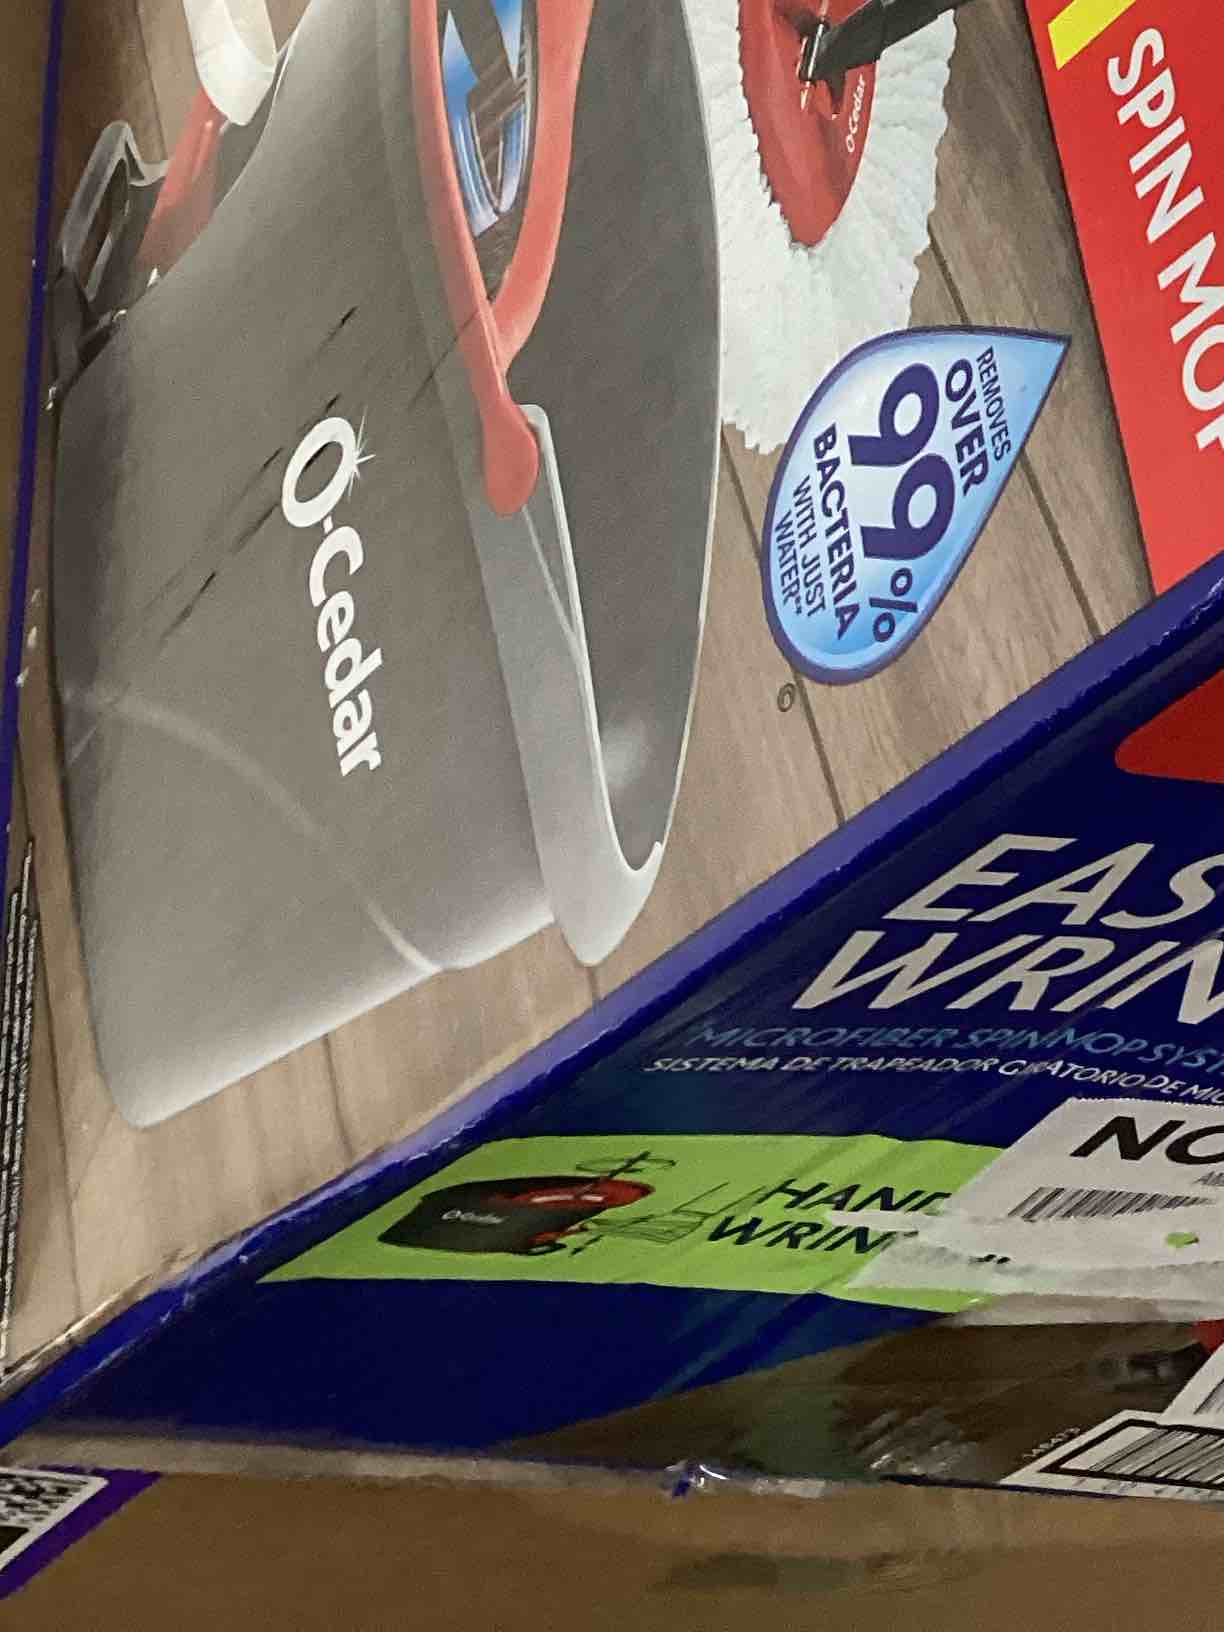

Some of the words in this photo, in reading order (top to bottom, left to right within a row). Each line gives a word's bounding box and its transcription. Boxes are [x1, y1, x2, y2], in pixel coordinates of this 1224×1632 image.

[1108, 27, 1205, 243] SPIN
[945, 359, 990, 496] OVER
[976, 345, 1012, 462] REMOVES
[792, 475, 815, 549] WITH
[813, 421, 861, 641] BACTERIA
[848, 362, 957, 643] 99%
[281, 416, 383, 777] O-Cedar
[800, 549, 827, 618] JUST
[644, 1055, 780, 1072] SISTEMA
[780, 1056, 830, 1072] DE
[828, 1055, 999, 1074] TRAPEADOR
[1143, 1075, 1186, 1095] DE
[685, 1023, 958, 1049] MICROFIBER
[952, 1027, 1048, 1049] SPIN
[1034, 1025, 1148, 1055] MOP
[708, 1215, 919, 1254] WRIN
